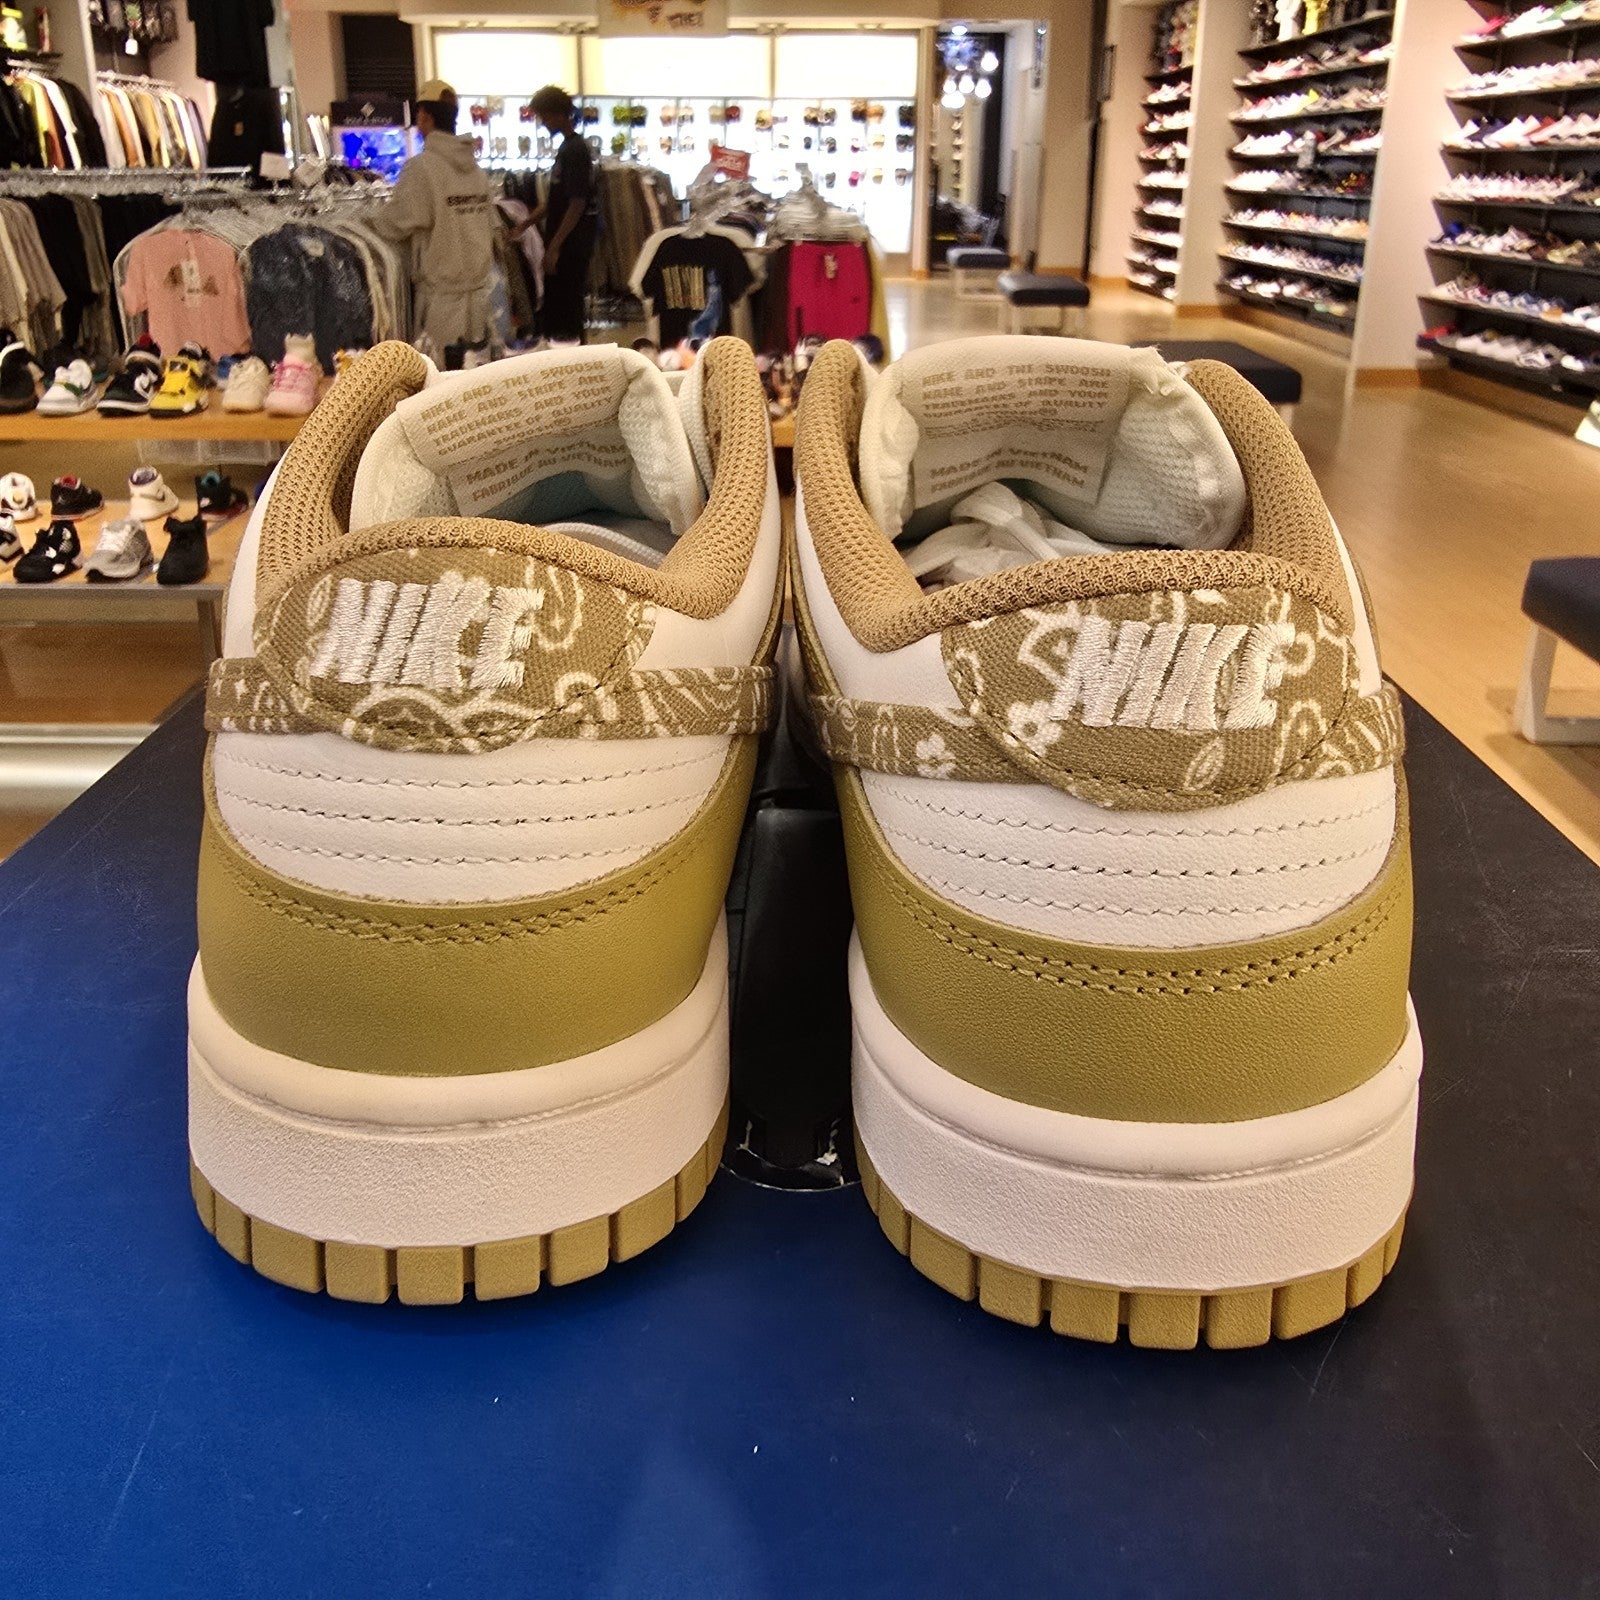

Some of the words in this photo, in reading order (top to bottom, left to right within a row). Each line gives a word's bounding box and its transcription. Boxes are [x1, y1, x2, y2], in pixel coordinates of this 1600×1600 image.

[421, 398, 454, 420] NIKE
[463, 384, 492, 402] AND
[540, 361, 604, 380] SWOOSH
[1045, 364, 1111, 377] SWOOSH
[427, 410, 467, 435] NAME
[478, 394, 507, 413] AND
[518, 380, 566, 400] STRIPE
[578, 374, 607, 385] ARE
[534, 396, 563, 411] AND
[573, 386, 611, 400] YOUR
[552, 396, 613, 418] QUALITY
[466, 457, 518, 485] MADE
[310, 576, 545, 690] NIKE
[1049, 614, 1295, 730] NIKE
